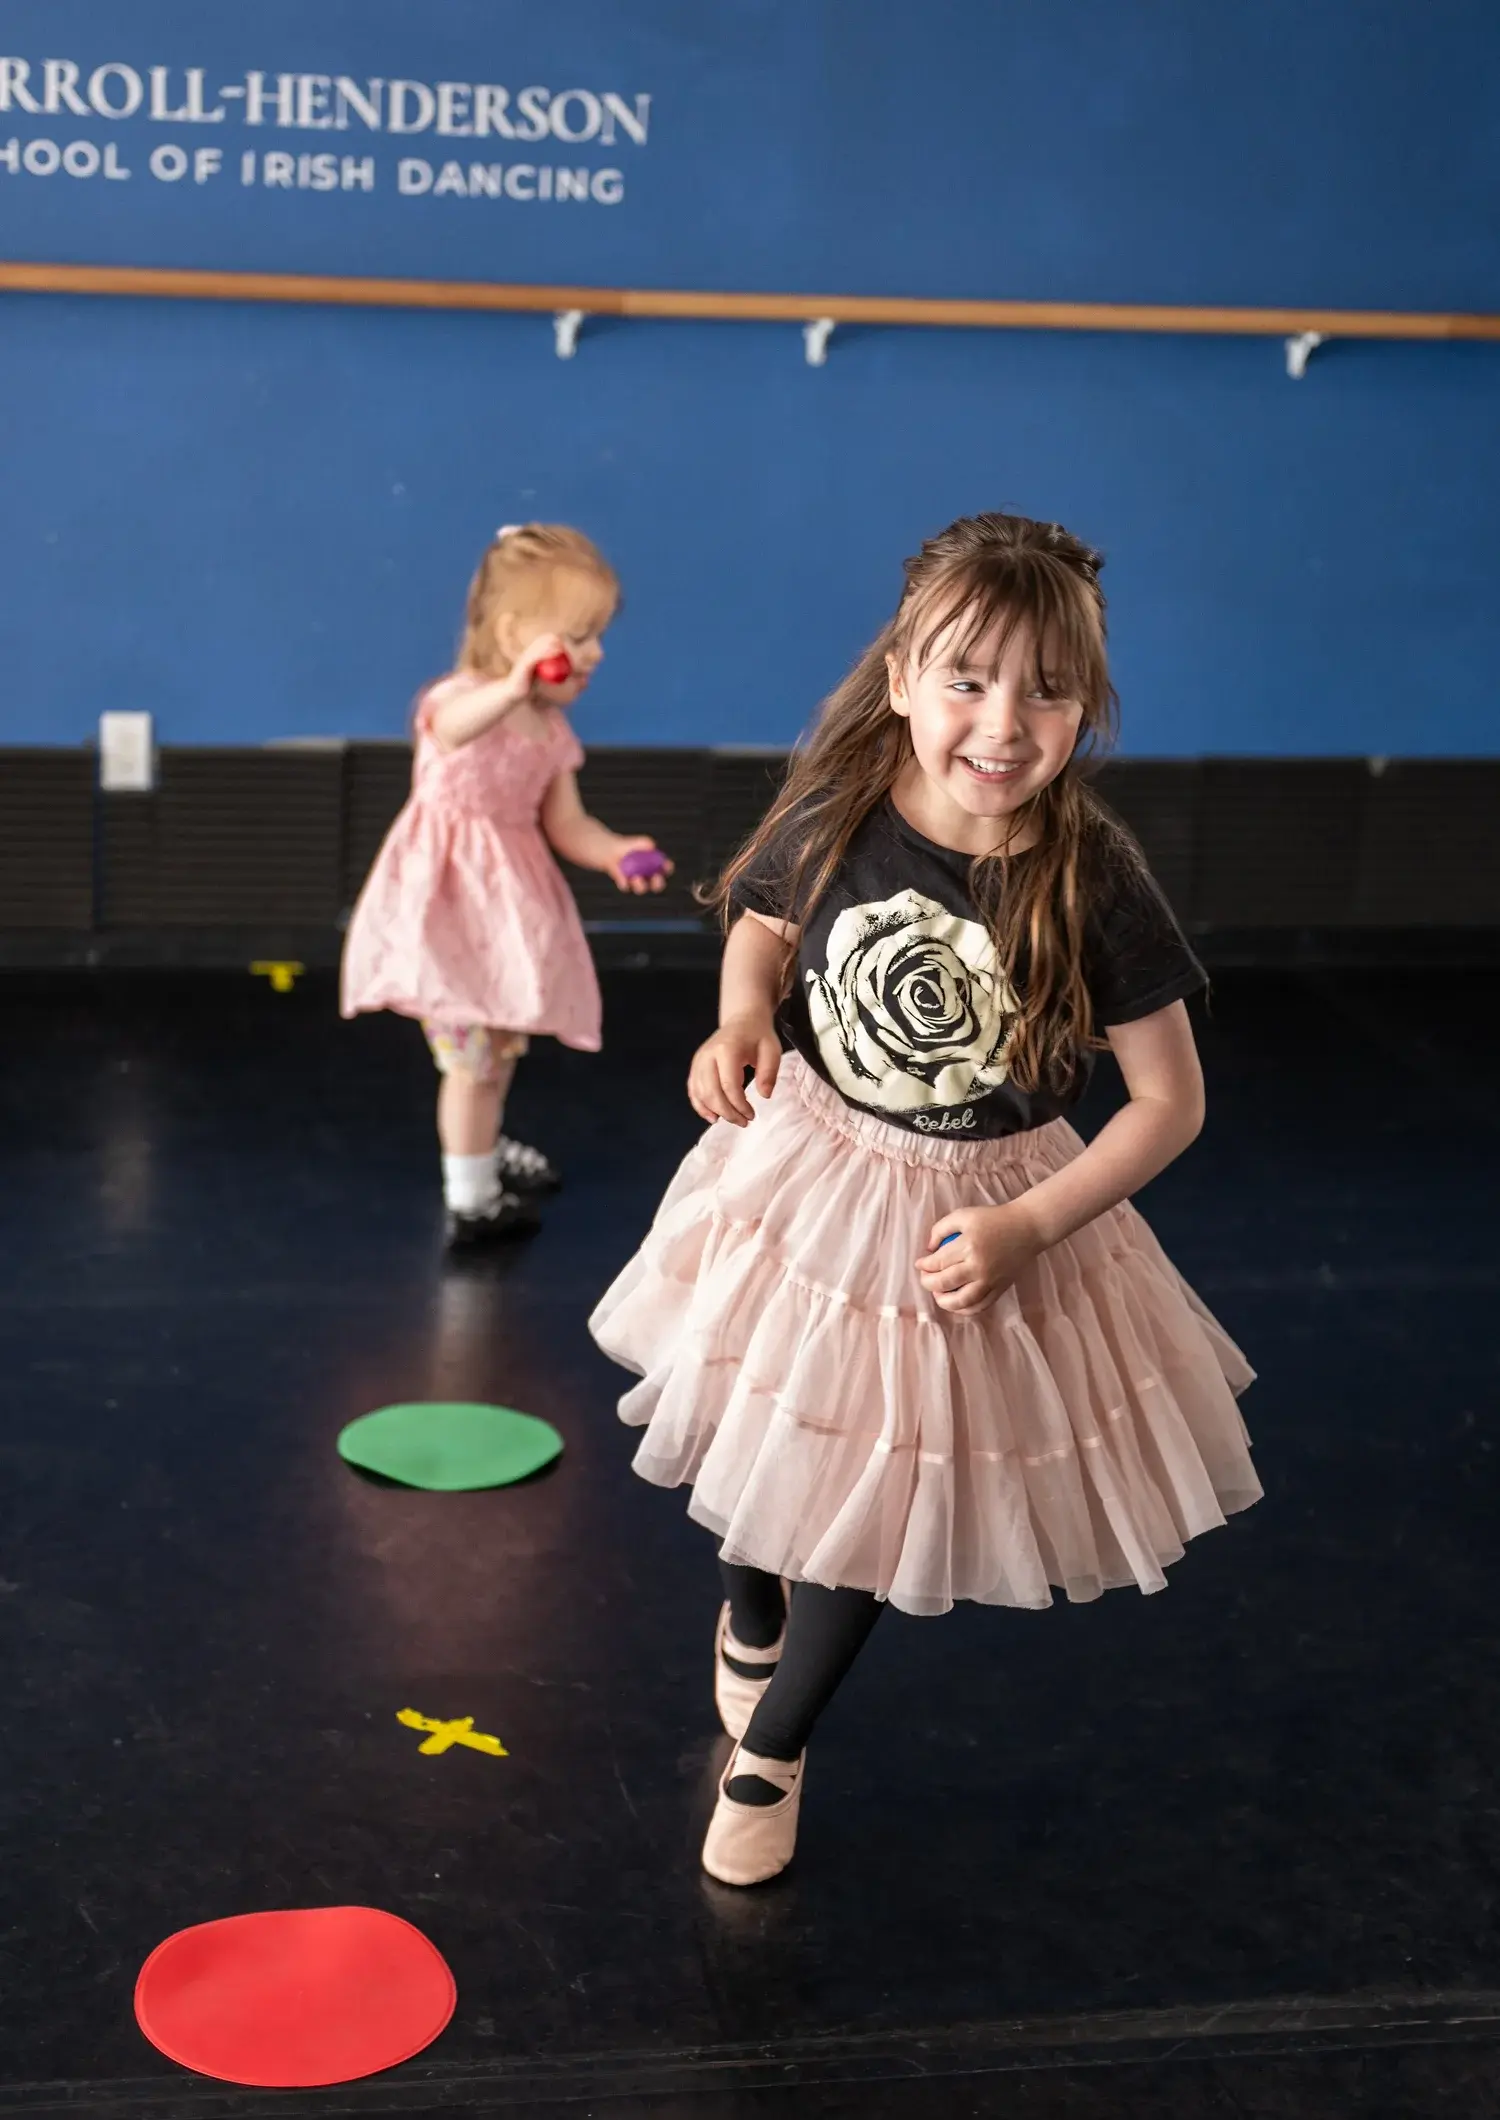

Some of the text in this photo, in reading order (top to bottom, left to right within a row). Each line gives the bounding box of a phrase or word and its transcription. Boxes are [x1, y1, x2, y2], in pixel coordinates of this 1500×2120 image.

[0, 56, 652, 146] RROLL-HENDERSON
[150, 144, 223, 186] OF
[241, 149, 375, 193] IRISH
[397, 158, 625, 205] DANCING
[913, 1108, 977, 1132] Rebel
